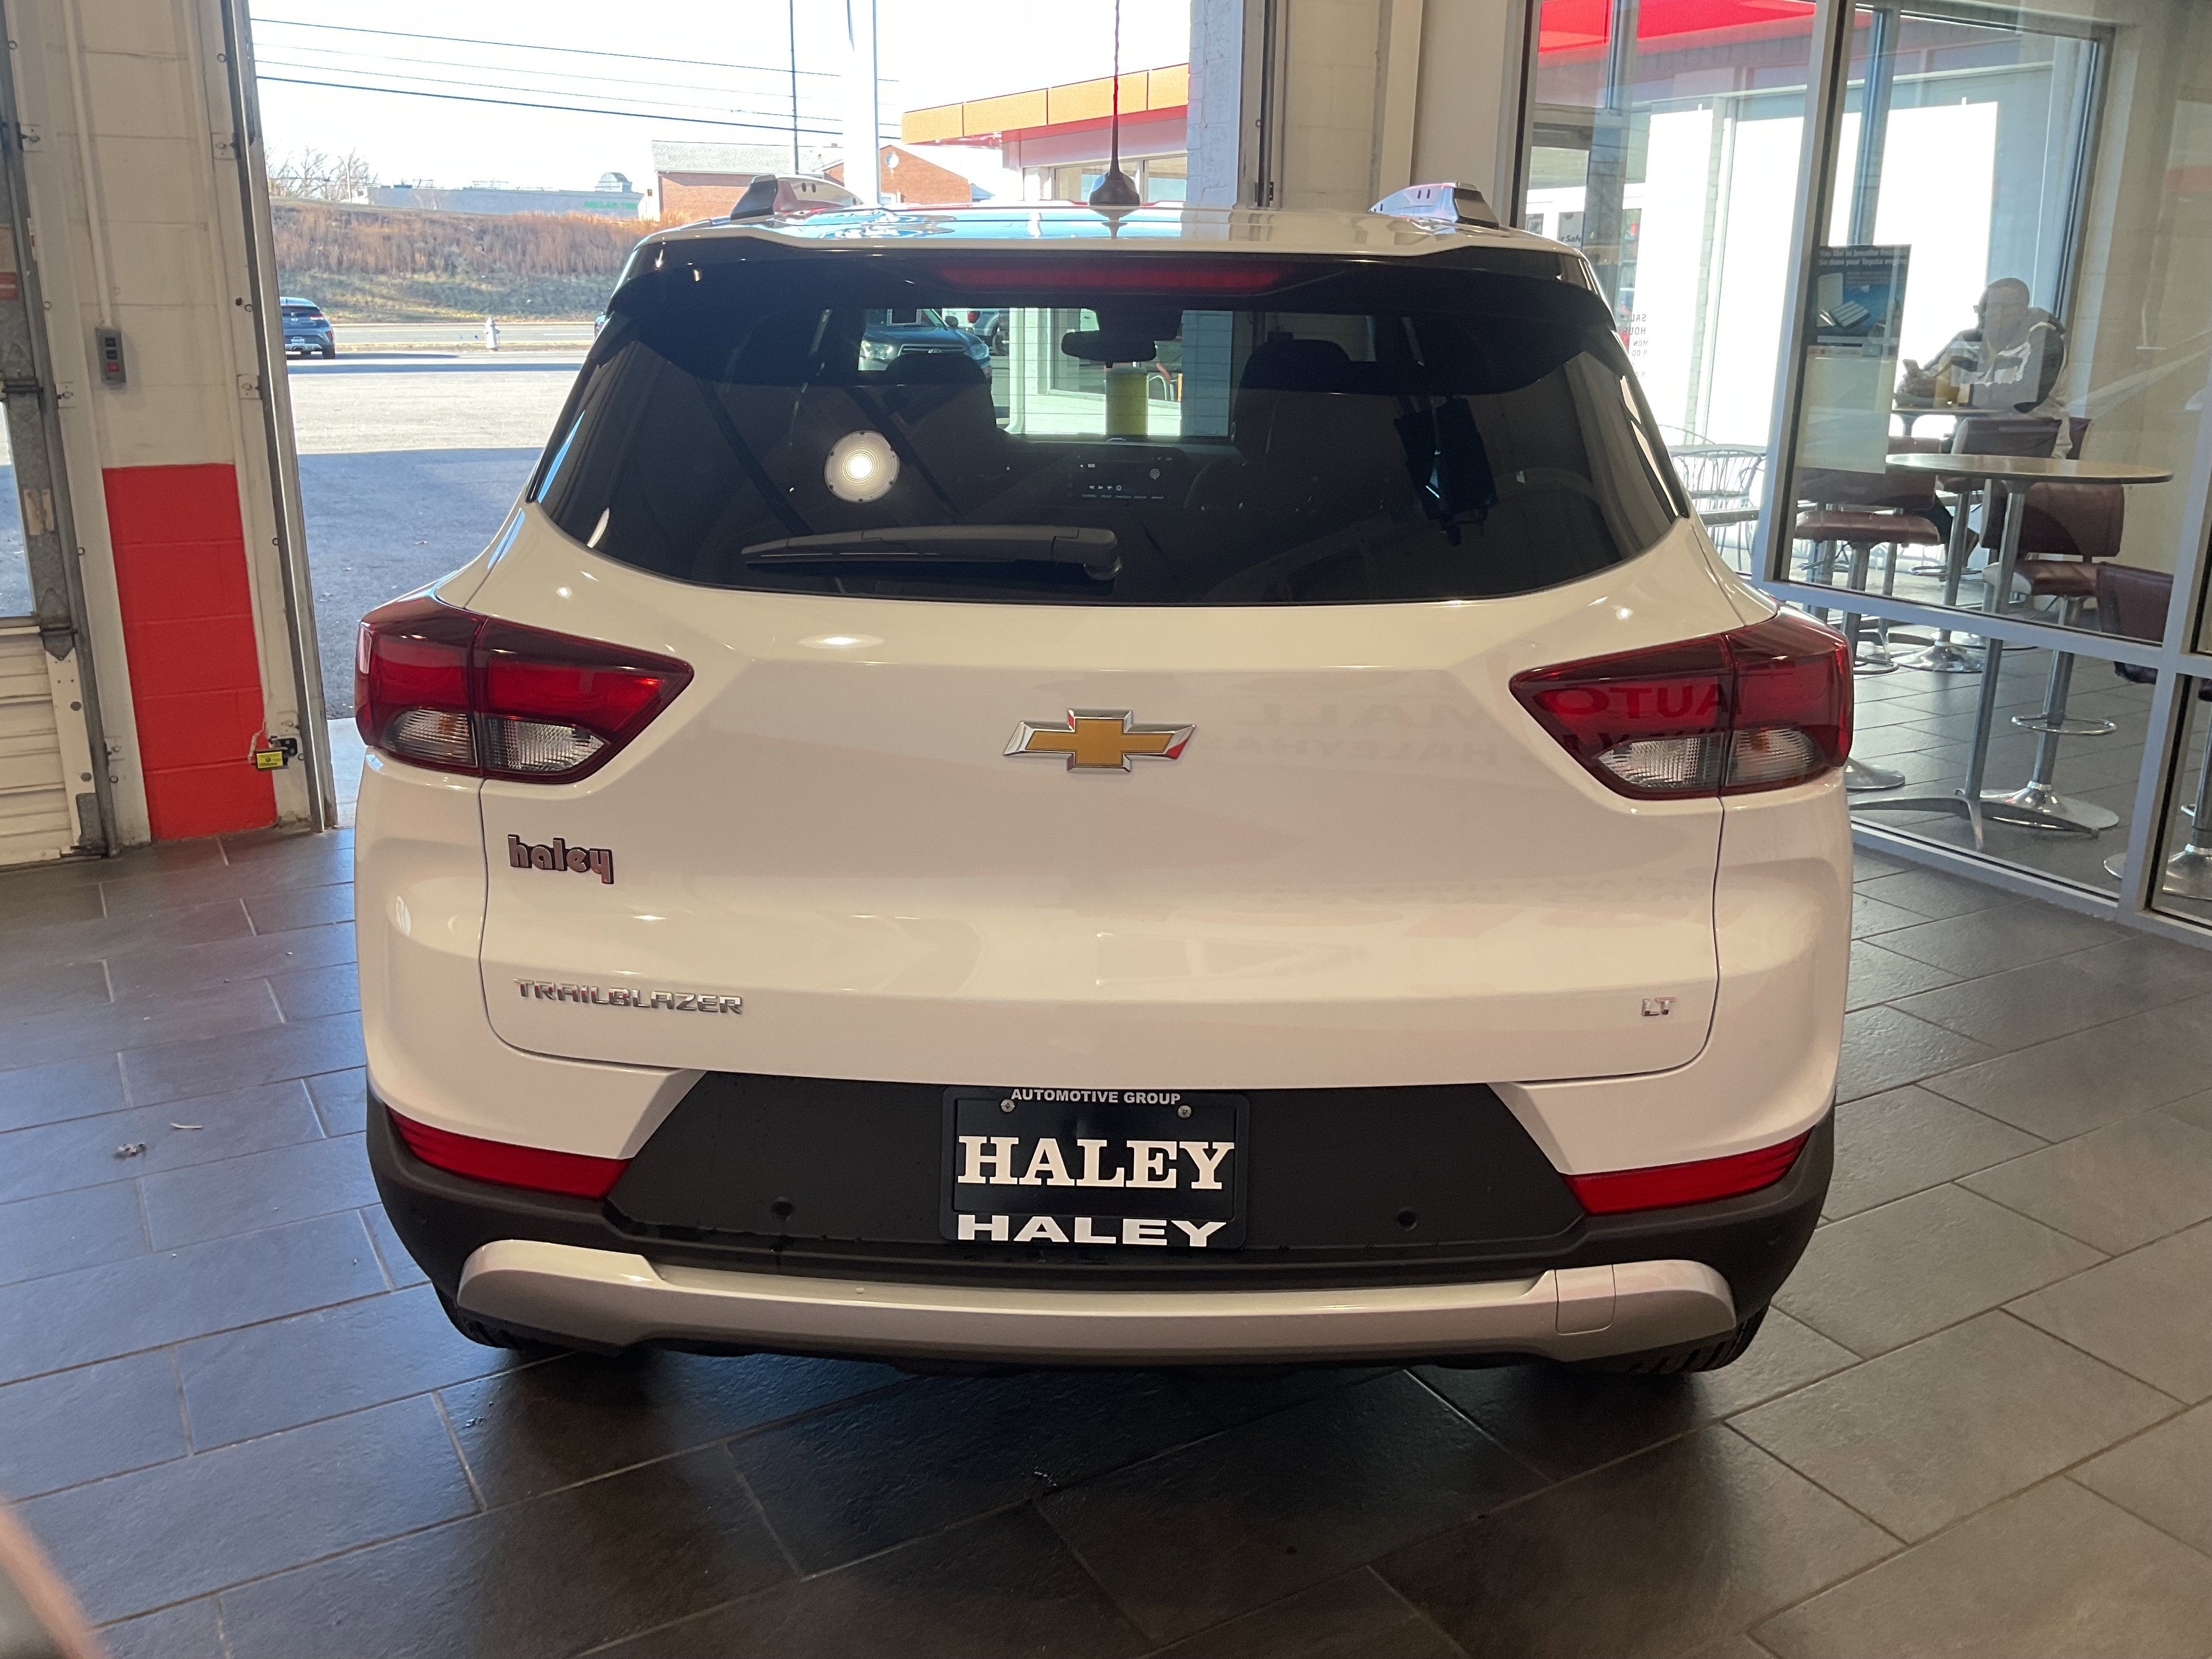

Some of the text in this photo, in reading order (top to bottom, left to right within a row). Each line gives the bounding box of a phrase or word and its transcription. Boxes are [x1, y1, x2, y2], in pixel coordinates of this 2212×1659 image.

[1861, 258, 1883, 266] Toyota
[507, 834, 614, 884] haley
[513, 978, 743, 1014] TRAILBLAZER
[1641, 997, 1677, 1017] LT
[1011, 1088, 1181, 1105] AUTOMOTIVE GROUP
[957, 1135, 1235, 1190] HALEY
[957, 1214, 1227, 1248] HALEY
